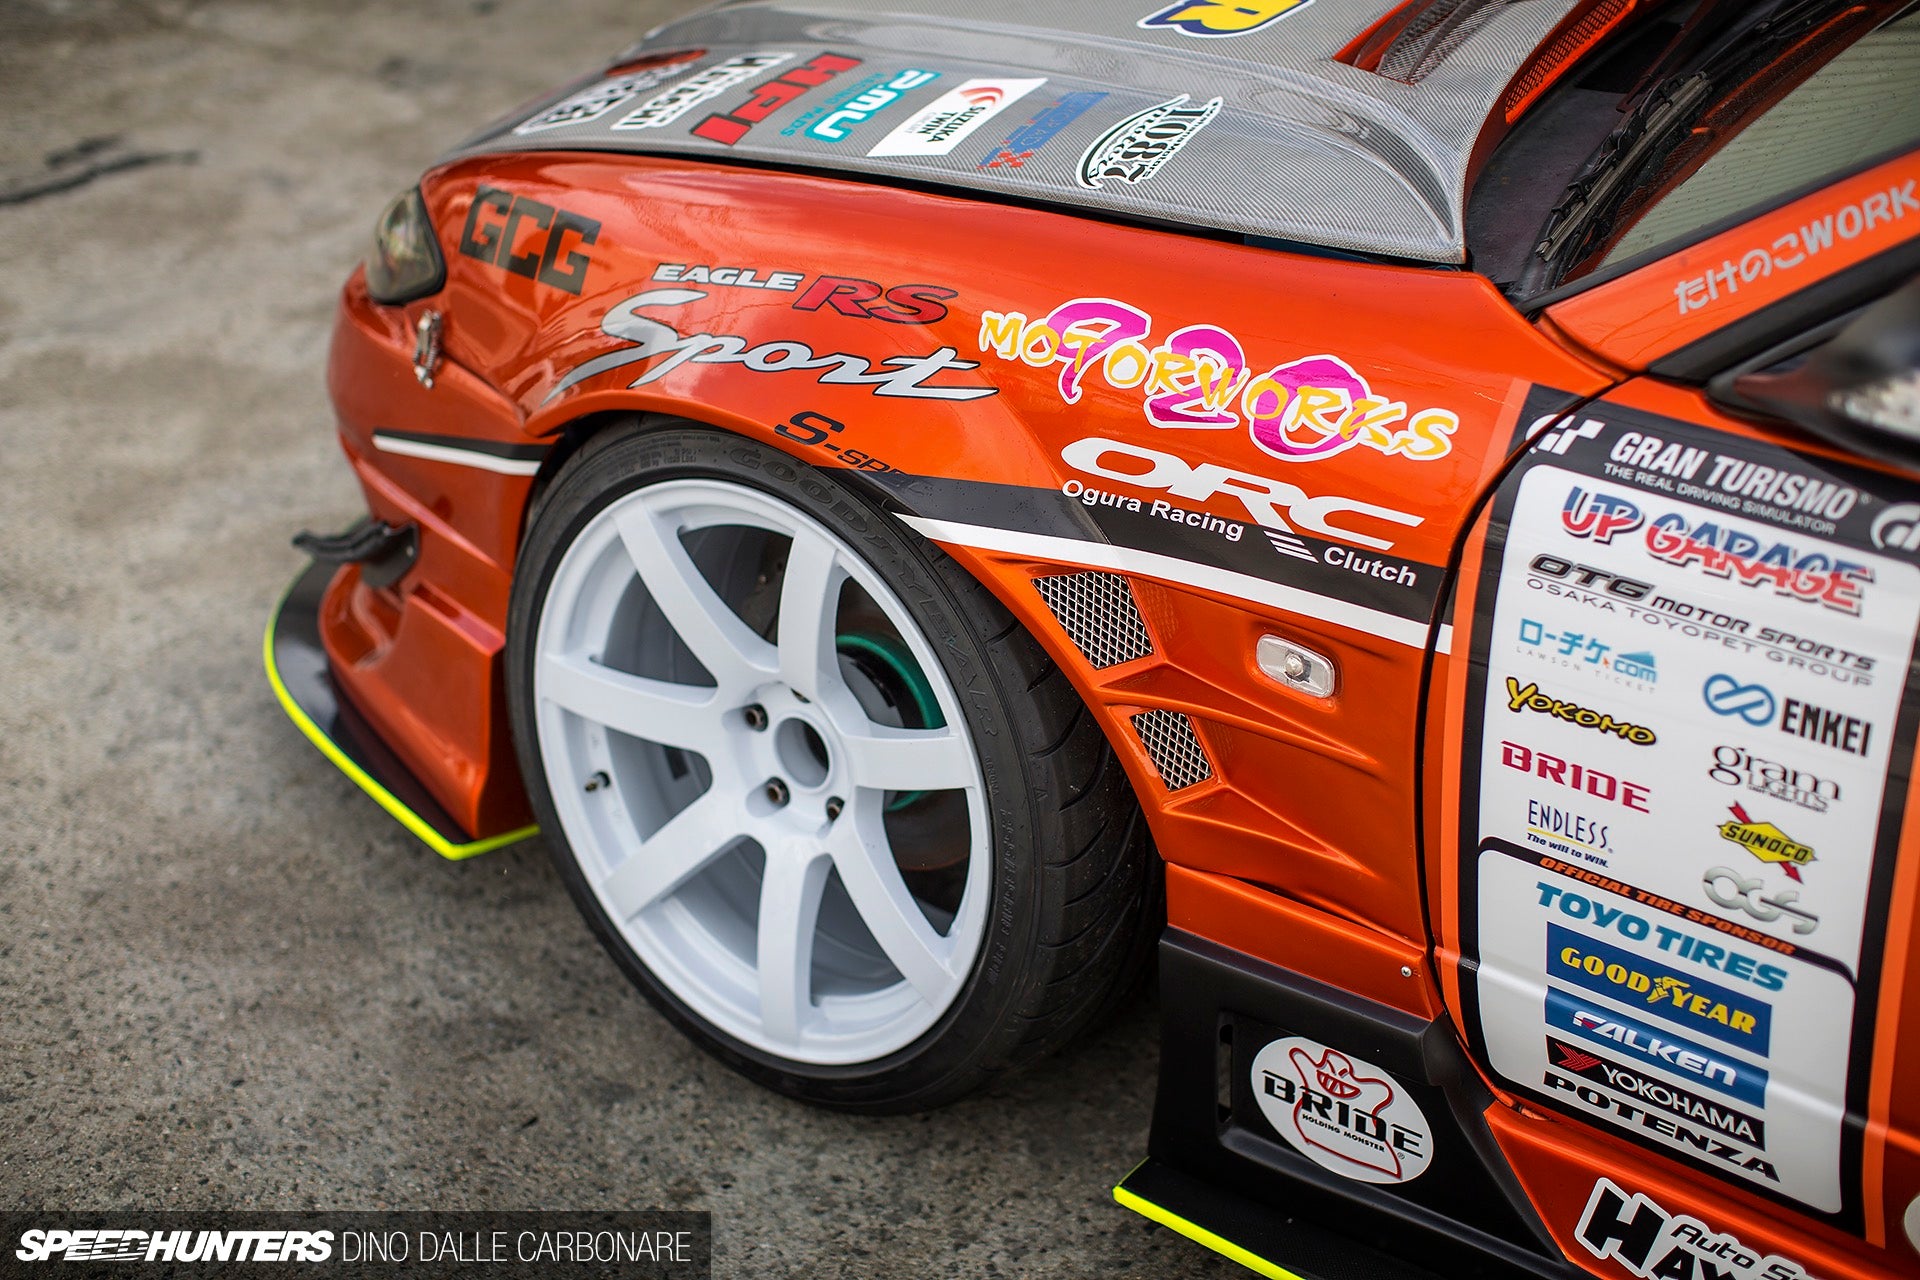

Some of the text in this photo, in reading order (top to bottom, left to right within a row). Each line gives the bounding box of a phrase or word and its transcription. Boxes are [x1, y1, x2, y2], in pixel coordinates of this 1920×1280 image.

[690, 53, 862, 146] HPI
[780, 107, 824, 136] PADS
[916, 112, 951, 135] TWIN
[926, 105, 986, 143] SUZUKA
[1103, 108, 1208, 182] 1087
[459, 185, 602, 296] GCG
[651, 263, 959, 325] EAGLE RS
[542, 288, 1000, 403] Sport
[979, 310, 1460, 461] MOTORWORKS
[1060, 437, 1426, 551] ORC
[1605, 462, 1837, 535] THE REAL DRIVING SIMULATOR
[1610, 432, 1709, 480] GRAN
[1705, 455, 1858, 520] TURISMO
[1062, 480, 1417, 587] Ogura Racing Clutch
[1562, 486, 1875, 618] UP GARAGE
[1516, 646, 1655, 694] LAWSON TICKET
[1527, 578, 1875, 688] OSAKA TOYOPET GROUP
[1651, 596, 1751, 634] MOTOR
[1756, 627, 1876, 672] SPORTS
[1505, 677, 1657, 746] YOKOMO
[1781, 698, 1874, 758] ENKEI
[1500, 740, 1652, 814] BRIDE
[1708, 746, 1841, 800] gram
[1527, 798, 1608, 849] ENDLESS
[1527, 832, 1609, 868] The will to WIN.
[1725, 823, 1811, 862] SUNOCO
[1536, 881, 1789, 992] TOYO TIRES
[1539, 857, 1796, 955] OFFICIAL TIRE SPONSOR
[1560, 947, 1758, 1035] GOODYEAR
[1573, 1010, 1738, 1087] FALKEN
[1262, 1069, 1423, 1158] BRIDE
[1302, 1113, 1385, 1153] HOLDING MONSTER
[1543, 1070, 1781, 1183] POTENZA
[1601, 1063, 1757, 1142] YOKOHAMA
[1670, 1222, 1755, 1271] Auto
